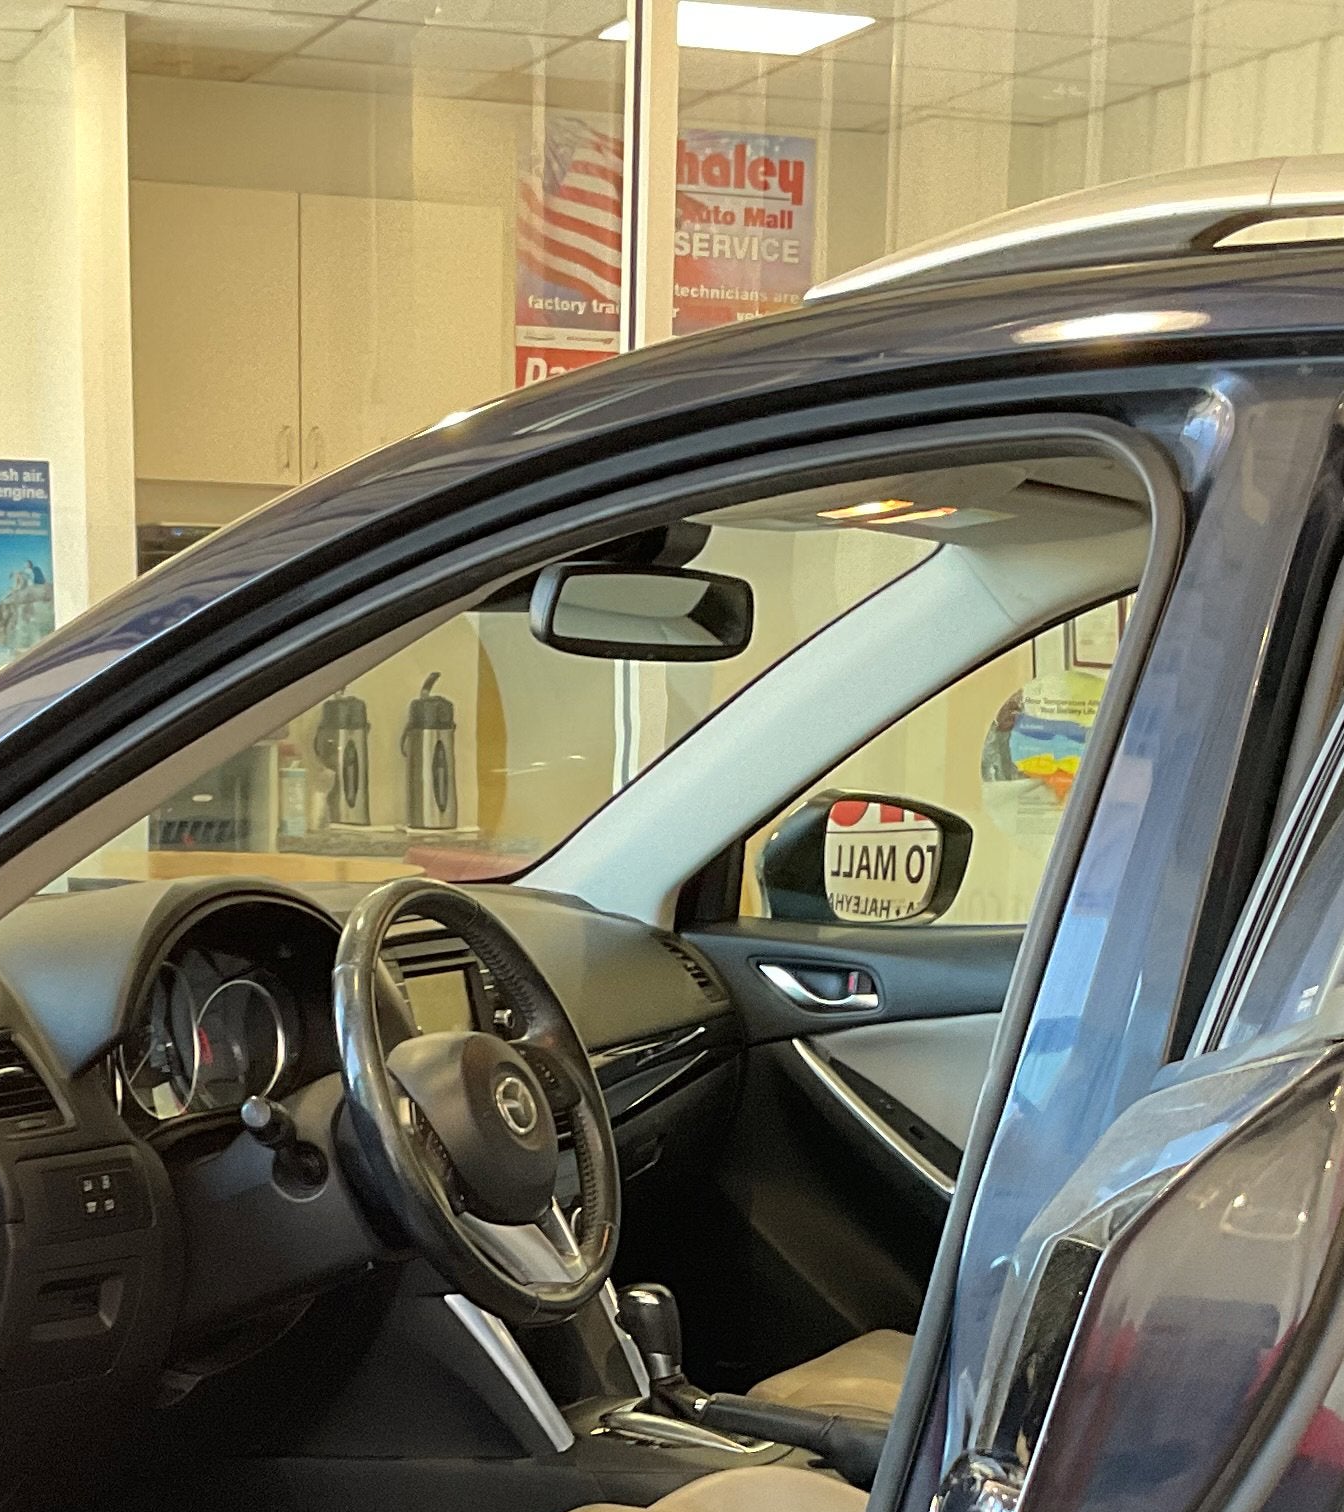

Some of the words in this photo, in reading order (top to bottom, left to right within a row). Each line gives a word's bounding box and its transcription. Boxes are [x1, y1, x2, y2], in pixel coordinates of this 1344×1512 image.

[677, 139, 805, 205] haley
[743, 207, 794, 230] Mall
[674, 230, 800, 263] SERVICE
[674, 284, 768, 302] technicians
[528, 294, 587, 315] factory
[22, 469, 45, 482] air.
